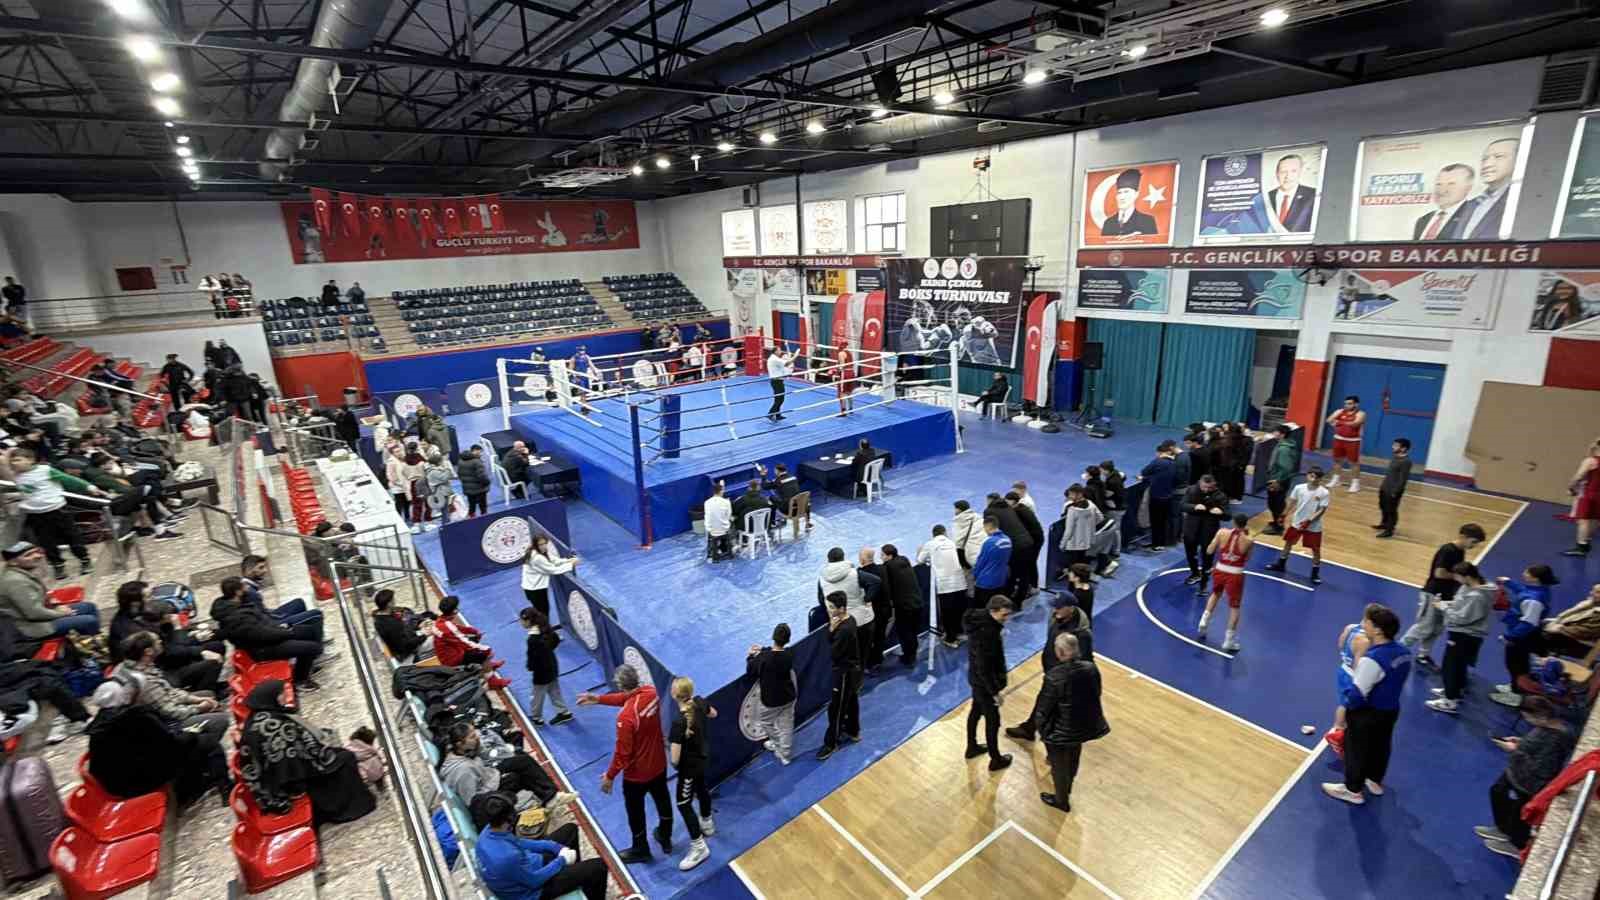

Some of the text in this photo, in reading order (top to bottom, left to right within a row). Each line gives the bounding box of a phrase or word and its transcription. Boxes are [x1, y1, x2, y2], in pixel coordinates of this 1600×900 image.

[1170, 244, 1541, 265] T.C. GENÇLİK VE SPOR BAKANLIĞI
[898, 288, 1011, 303] BOKS TURNUVASI
